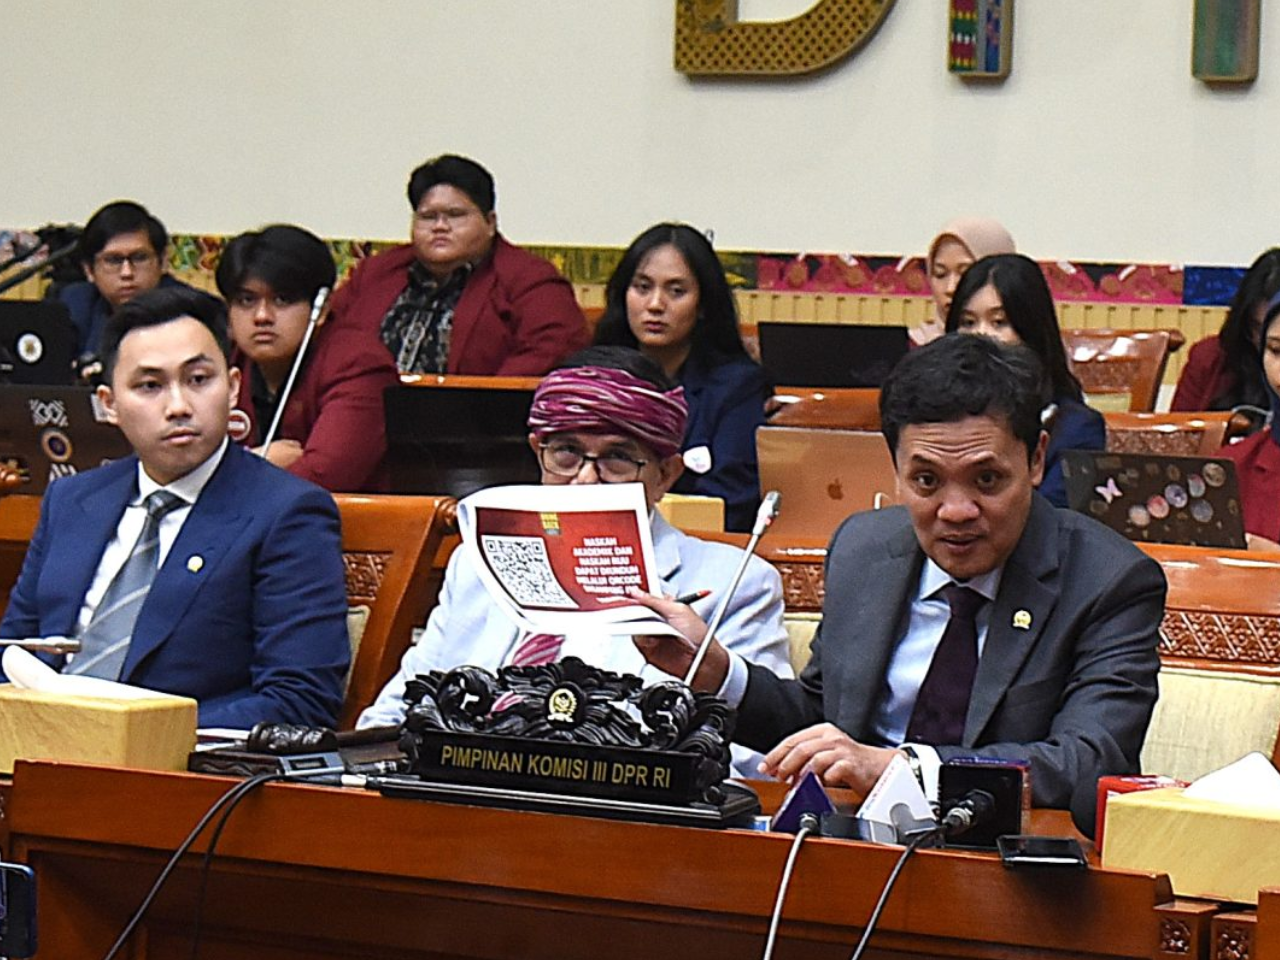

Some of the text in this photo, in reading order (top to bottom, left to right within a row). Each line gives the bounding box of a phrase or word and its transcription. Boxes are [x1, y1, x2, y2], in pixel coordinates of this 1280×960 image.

[440, 745, 671, 788] PIMPINAN KOMISI III DPR RI
